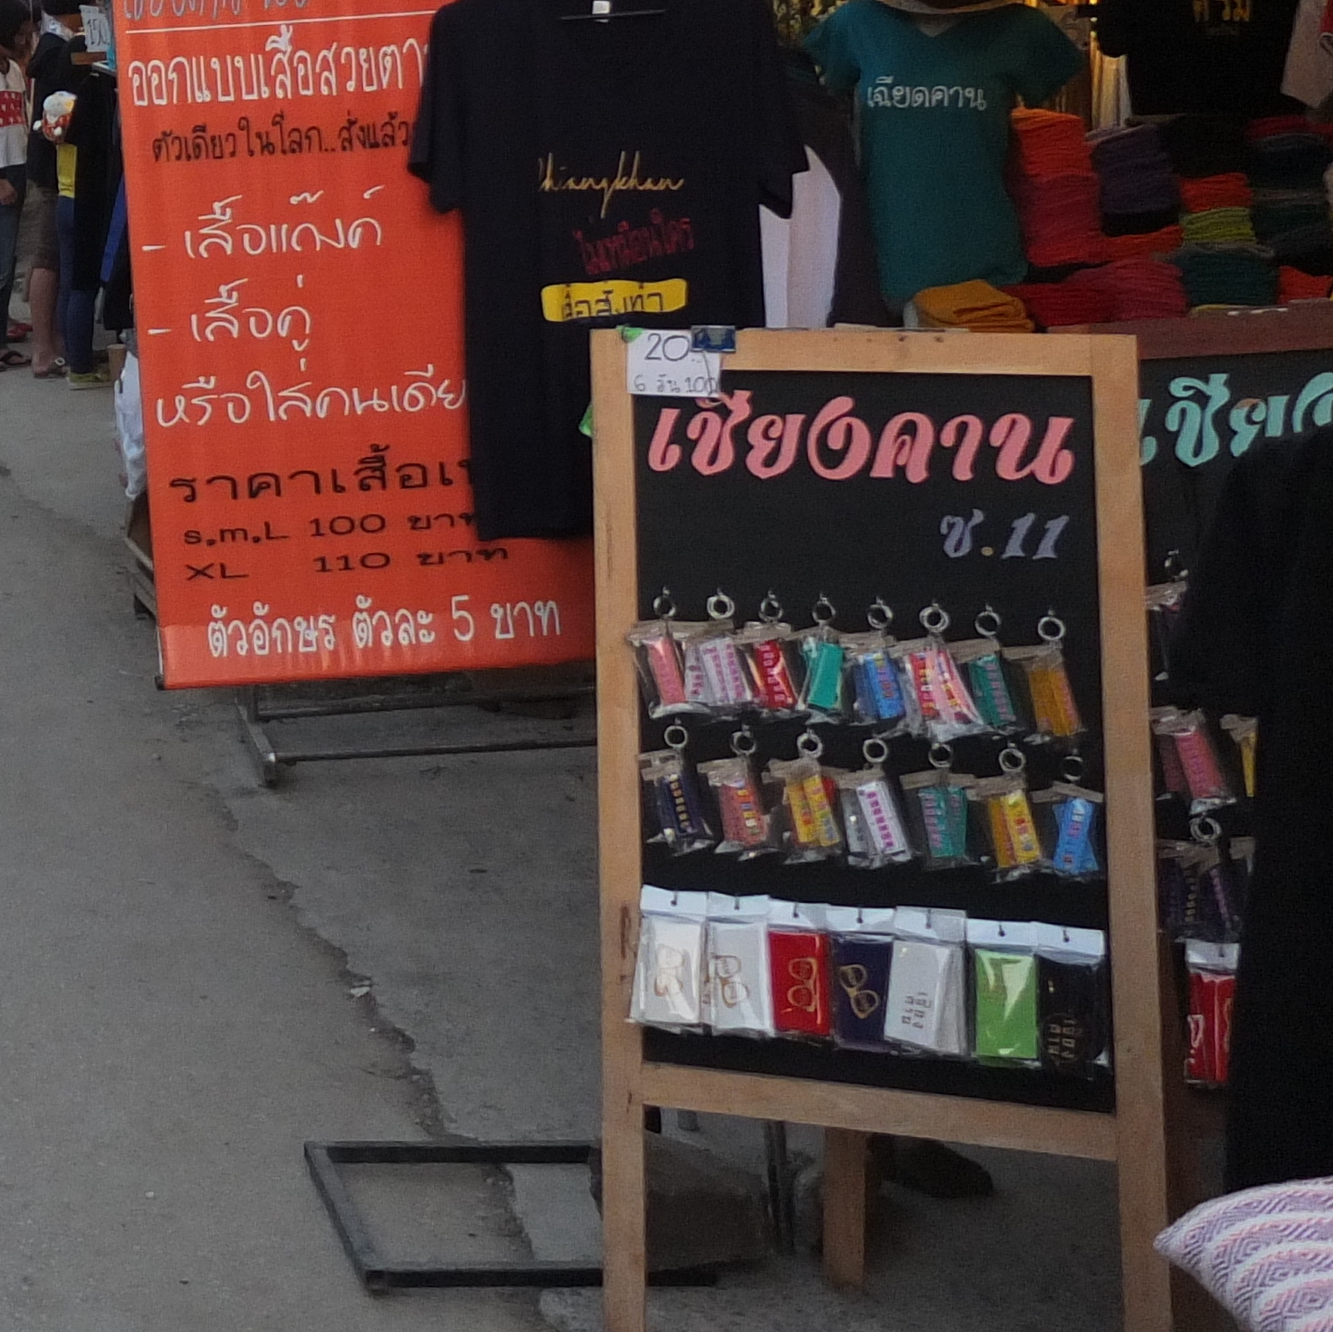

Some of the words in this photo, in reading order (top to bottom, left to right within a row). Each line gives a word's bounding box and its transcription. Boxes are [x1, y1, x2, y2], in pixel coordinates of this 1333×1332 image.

[128, 24, 429, 106] ออกแบบเสื้อสวยตา
[538, 150, 684, 219] hiangkhan
[633, 374, 646, 392] 6
[169, 443, 472, 504] ราคาเสื้อเ
[308, 512, 387, 538] 100
[185, 562, 250, 582] XL
[313, 551, 392, 574] 110
[415, 545, 510, 568] บาท
[206, 602, 337, 657] ตัวอักษร
[351, 594, 437, 650] ตัวละ
[450, 594, 475, 642] 5
[490, 599, 562, 640] บาท
